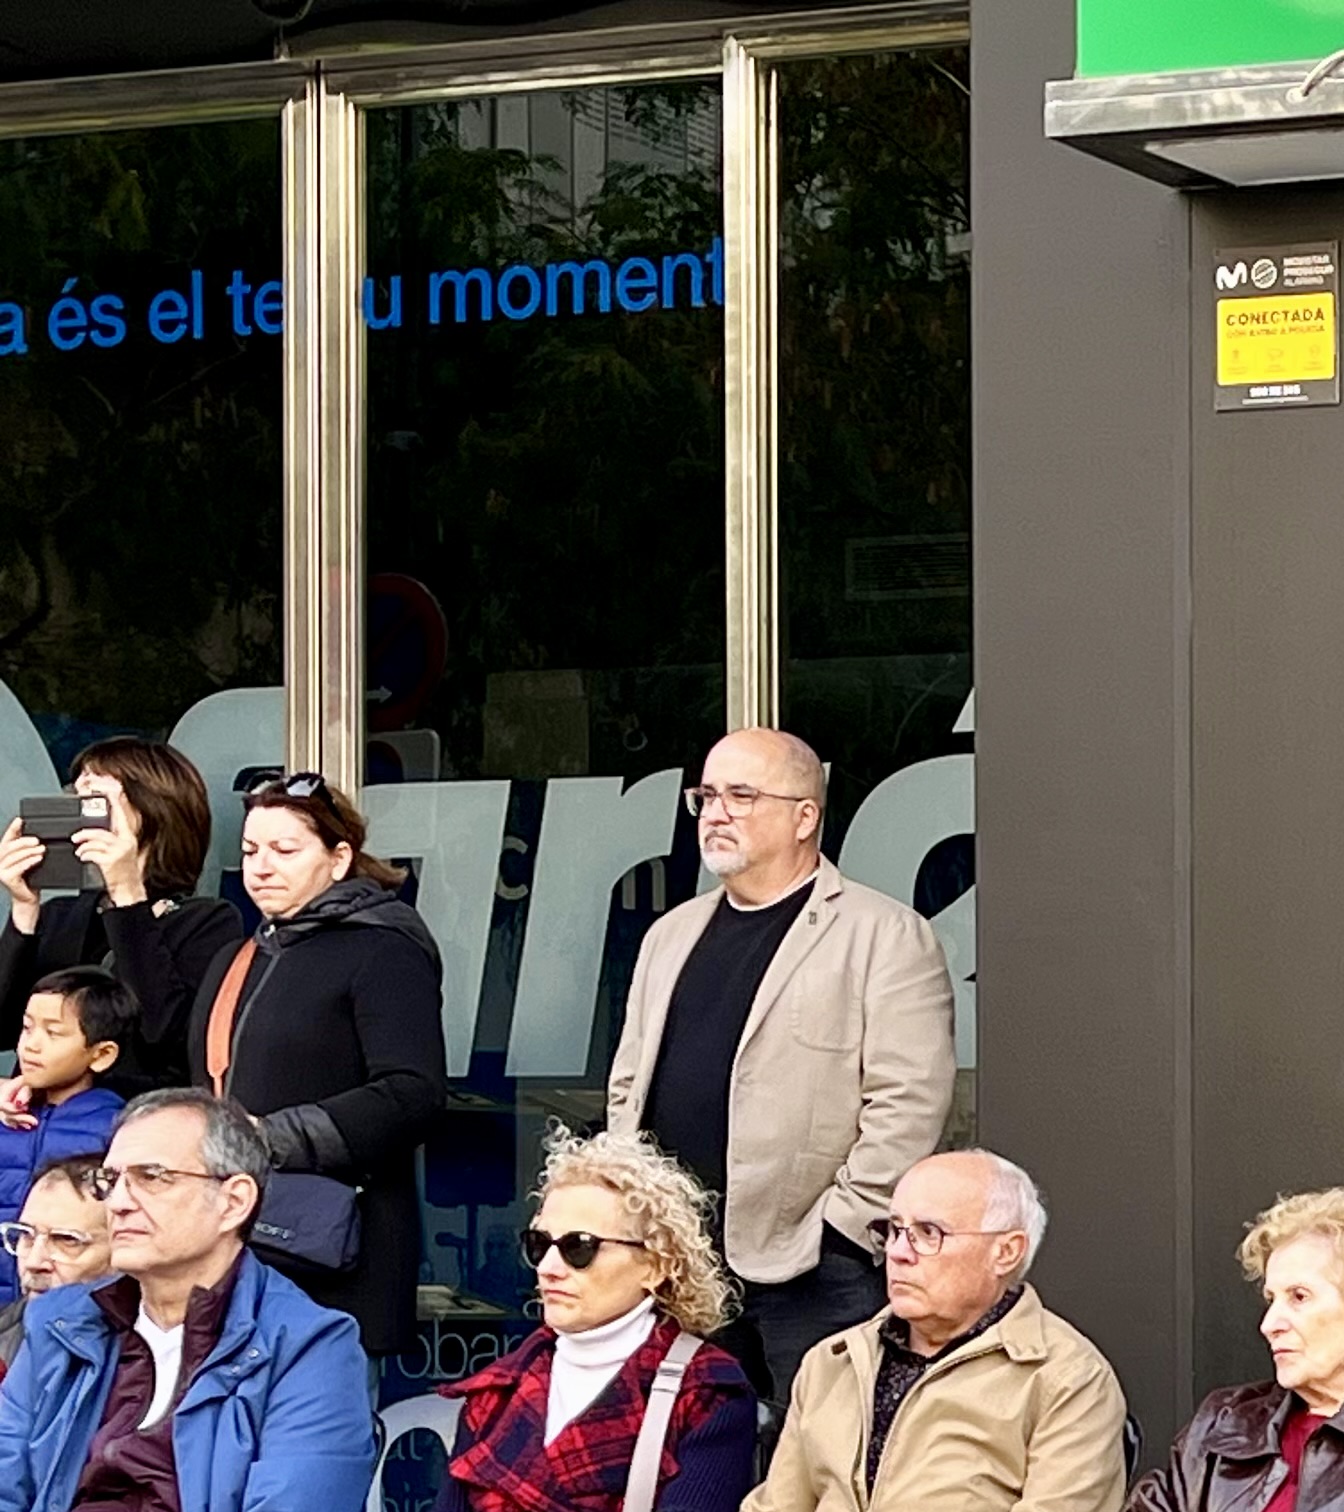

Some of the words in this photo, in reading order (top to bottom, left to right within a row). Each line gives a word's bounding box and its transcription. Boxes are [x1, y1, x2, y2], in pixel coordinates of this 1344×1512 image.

[48, 277, 127, 350] és
[149, 270, 203, 343] el
[429, 236, 724, 325] moment
[1226, 307, 1325, 326] CONECTADA
